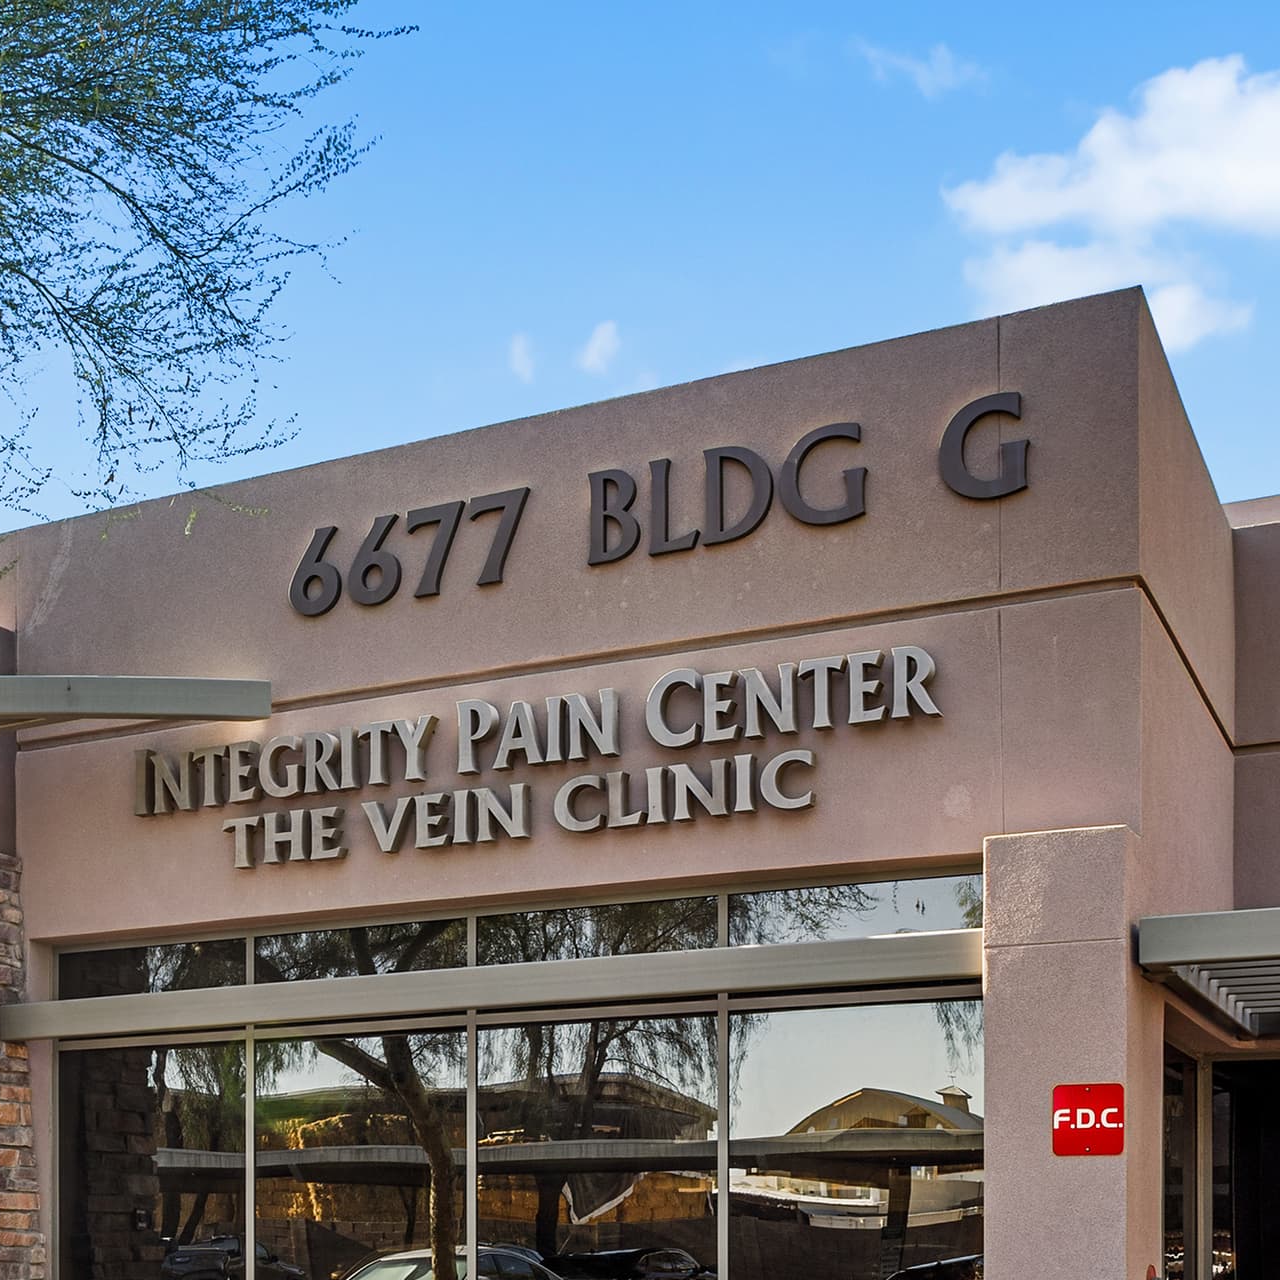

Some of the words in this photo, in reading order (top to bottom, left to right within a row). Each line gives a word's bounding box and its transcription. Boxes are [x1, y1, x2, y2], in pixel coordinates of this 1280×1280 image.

[288, 486, 530, 617] 6677
[587, 422, 868, 566] BLDG
[938, 391, 1031, 500] G
[139, 713, 438, 817] INTEGRITY
[455, 688, 621, 775] PAIN
[646, 645, 943, 750] CENTER
[222, 805, 347, 869] THE
[362, 782, 532, 853] VEIN
[554, 748, 817, 833] CLINIC
[1053, 1107, 1124, 1130] F.D.C.
